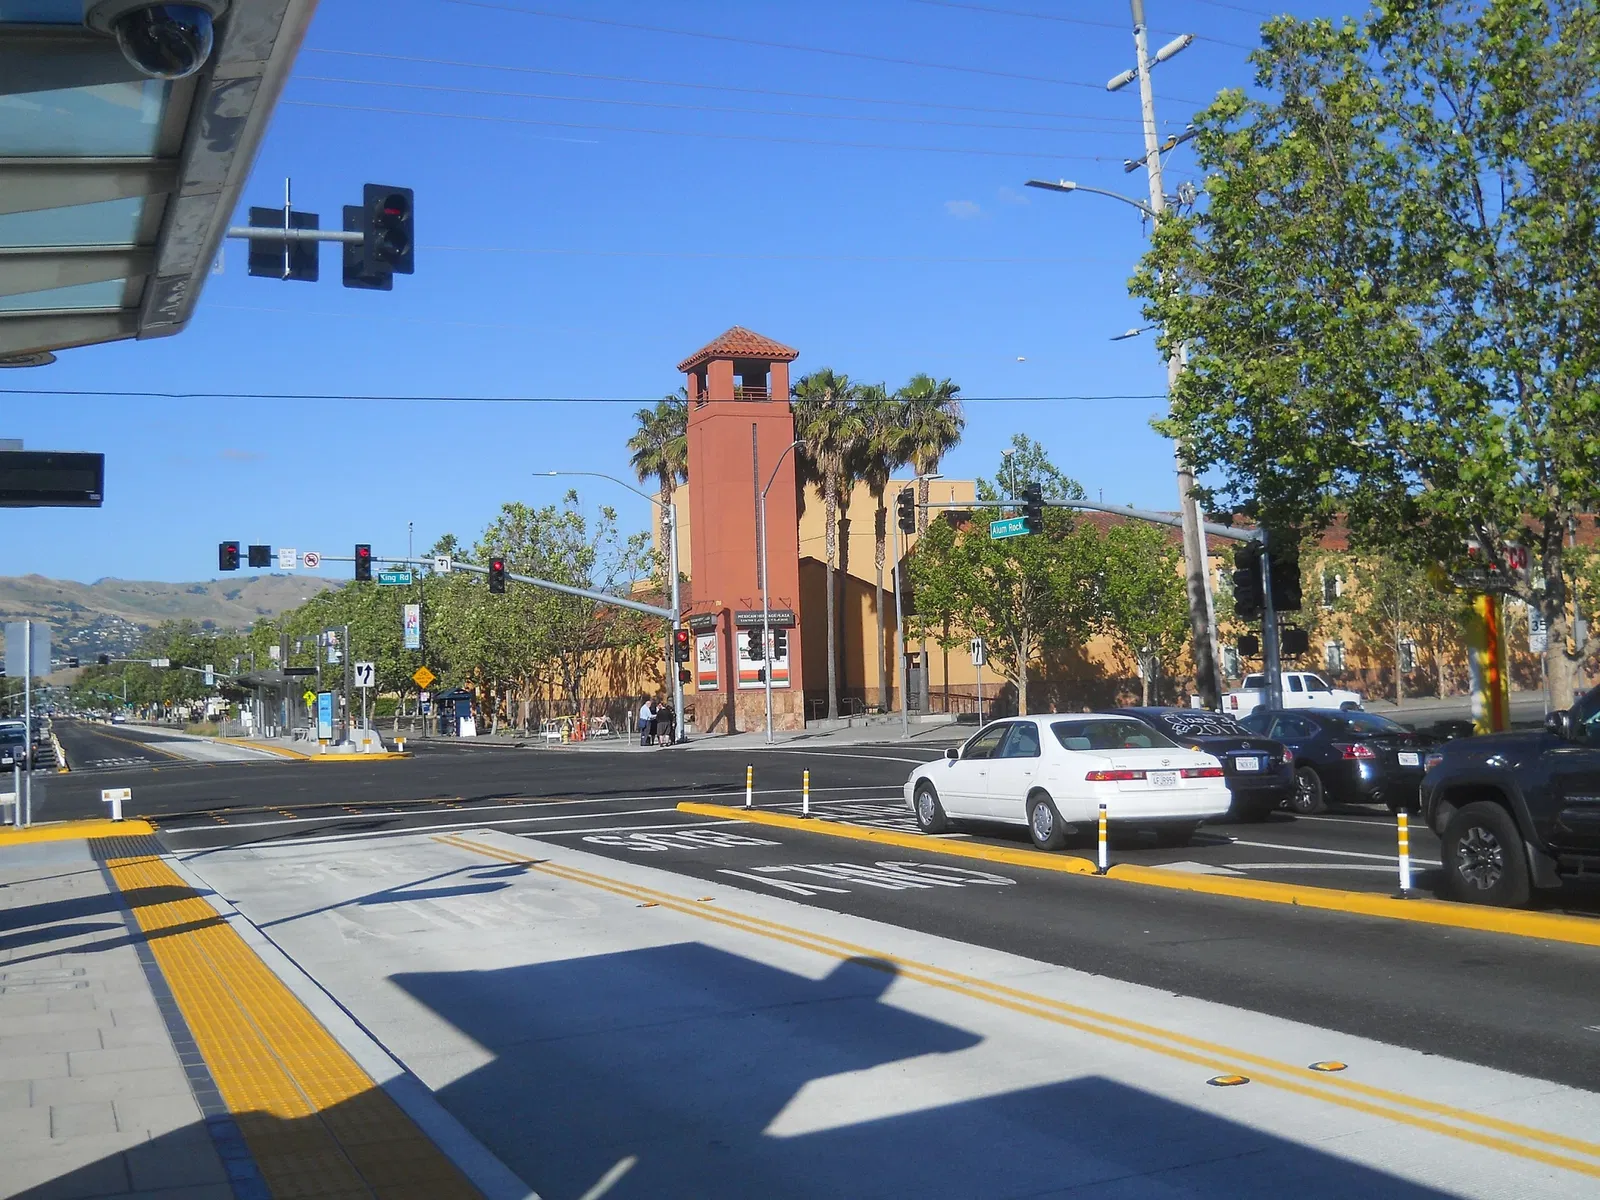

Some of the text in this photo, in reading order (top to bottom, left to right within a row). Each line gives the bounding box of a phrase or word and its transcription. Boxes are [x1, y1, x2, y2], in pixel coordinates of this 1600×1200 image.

[993, 521, 1023, 534] Alum Rock
[1531, 620, 1547, 632] 35
[1164, 715, 1217, 725] Class
[1190, 724, 1239, 736] 2017
